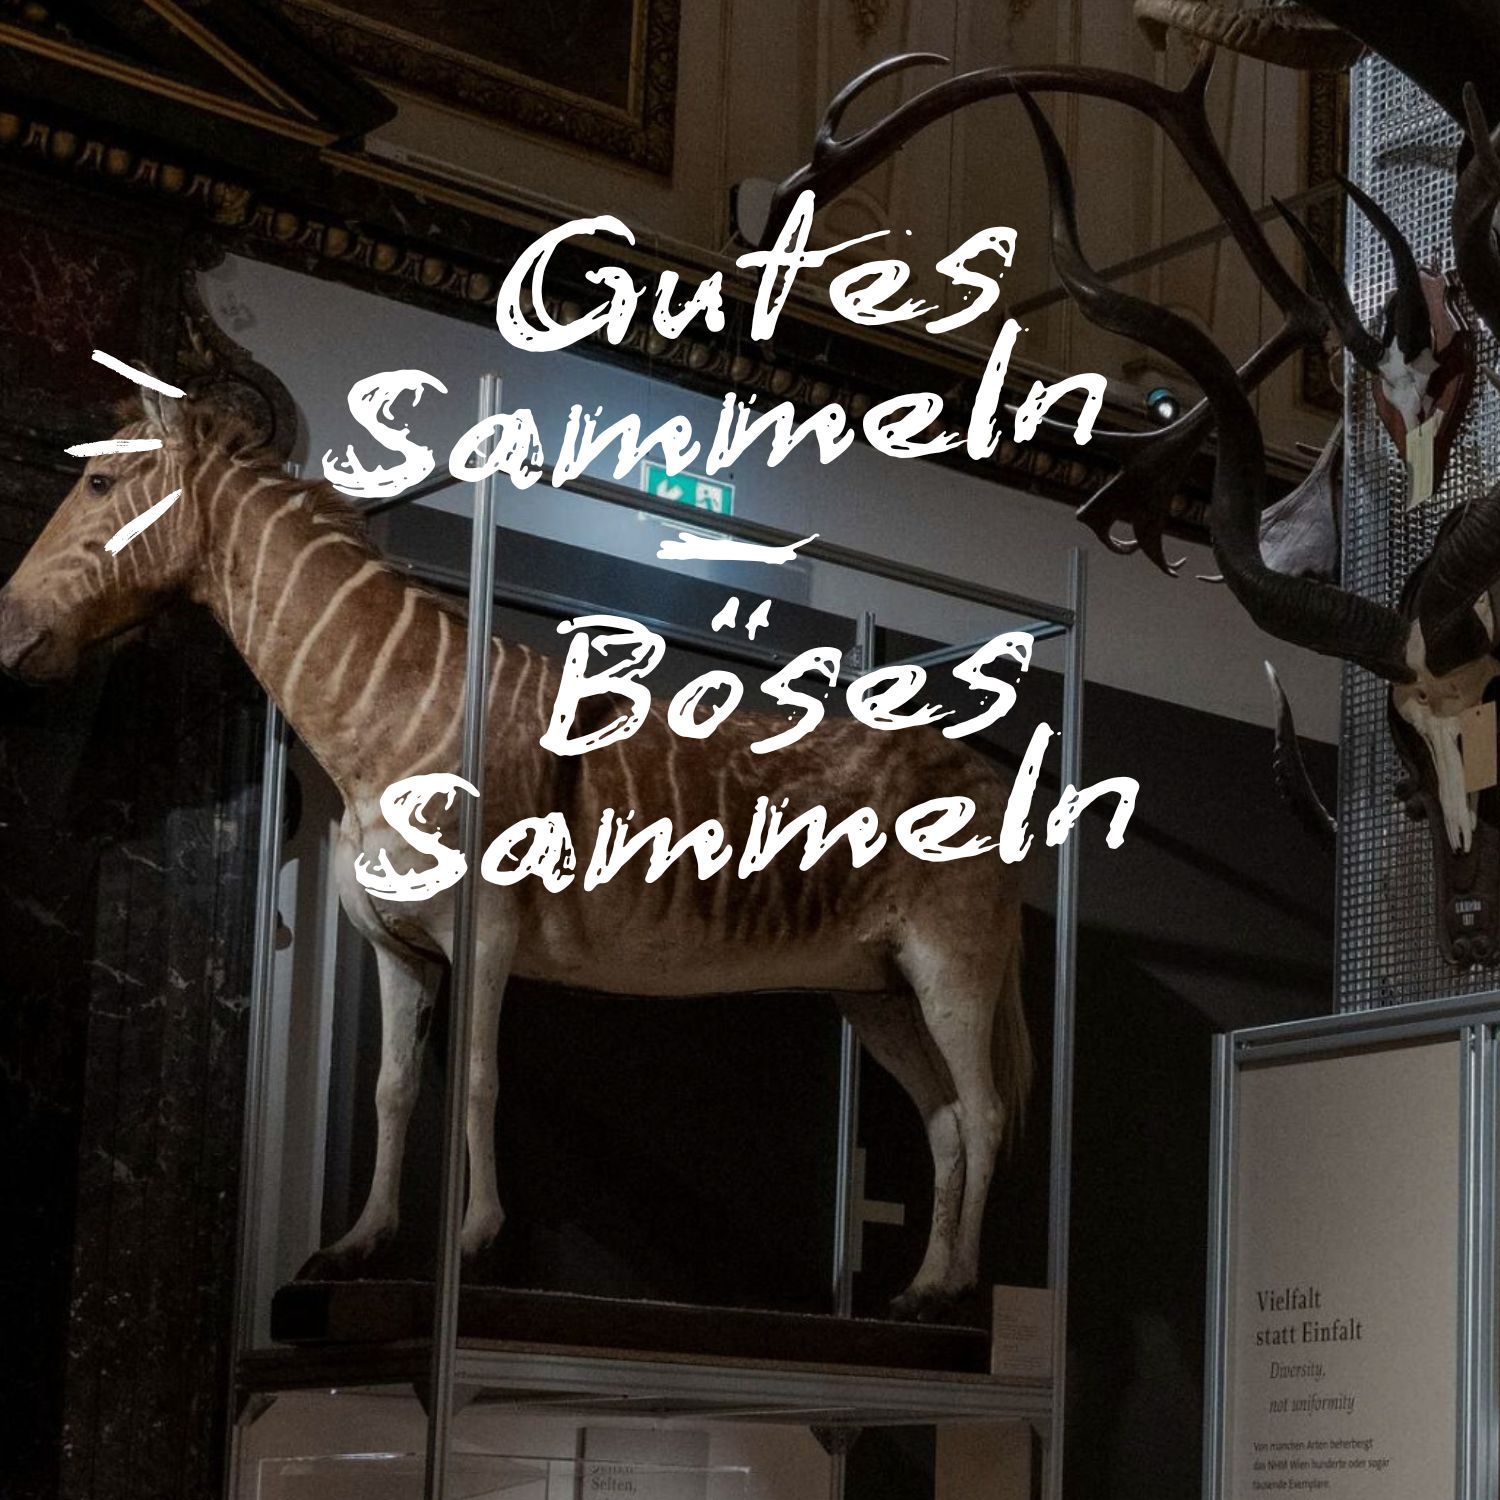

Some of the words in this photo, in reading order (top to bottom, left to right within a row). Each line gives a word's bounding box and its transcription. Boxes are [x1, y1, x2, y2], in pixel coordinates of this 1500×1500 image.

[1256, 1286, 1321, 1312] Vielfalt
[1255, 1326, 1296, 1346] statt
[1302, 1318, 1363, 1344] Einfalt
